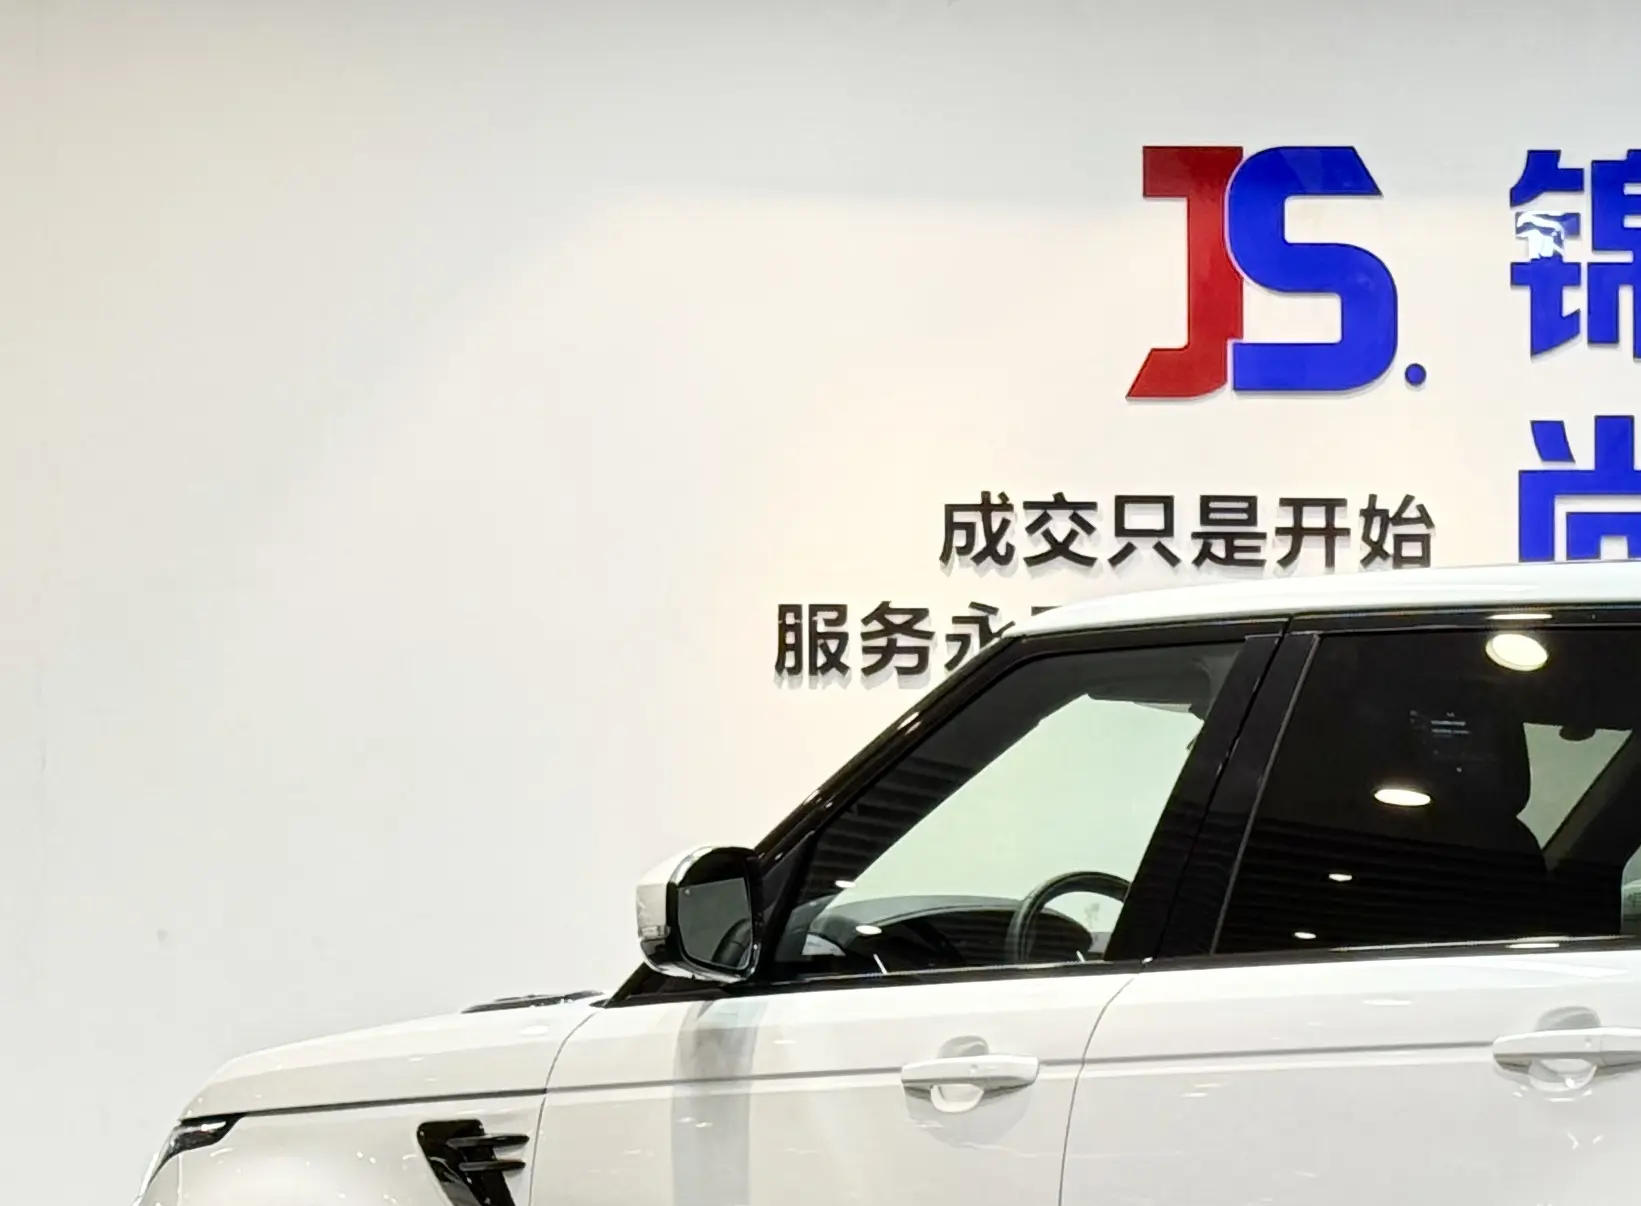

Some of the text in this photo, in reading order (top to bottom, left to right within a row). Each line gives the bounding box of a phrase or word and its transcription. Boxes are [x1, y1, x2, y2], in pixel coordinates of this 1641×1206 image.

[938, 490, 1434, 568] 成交只是开始
